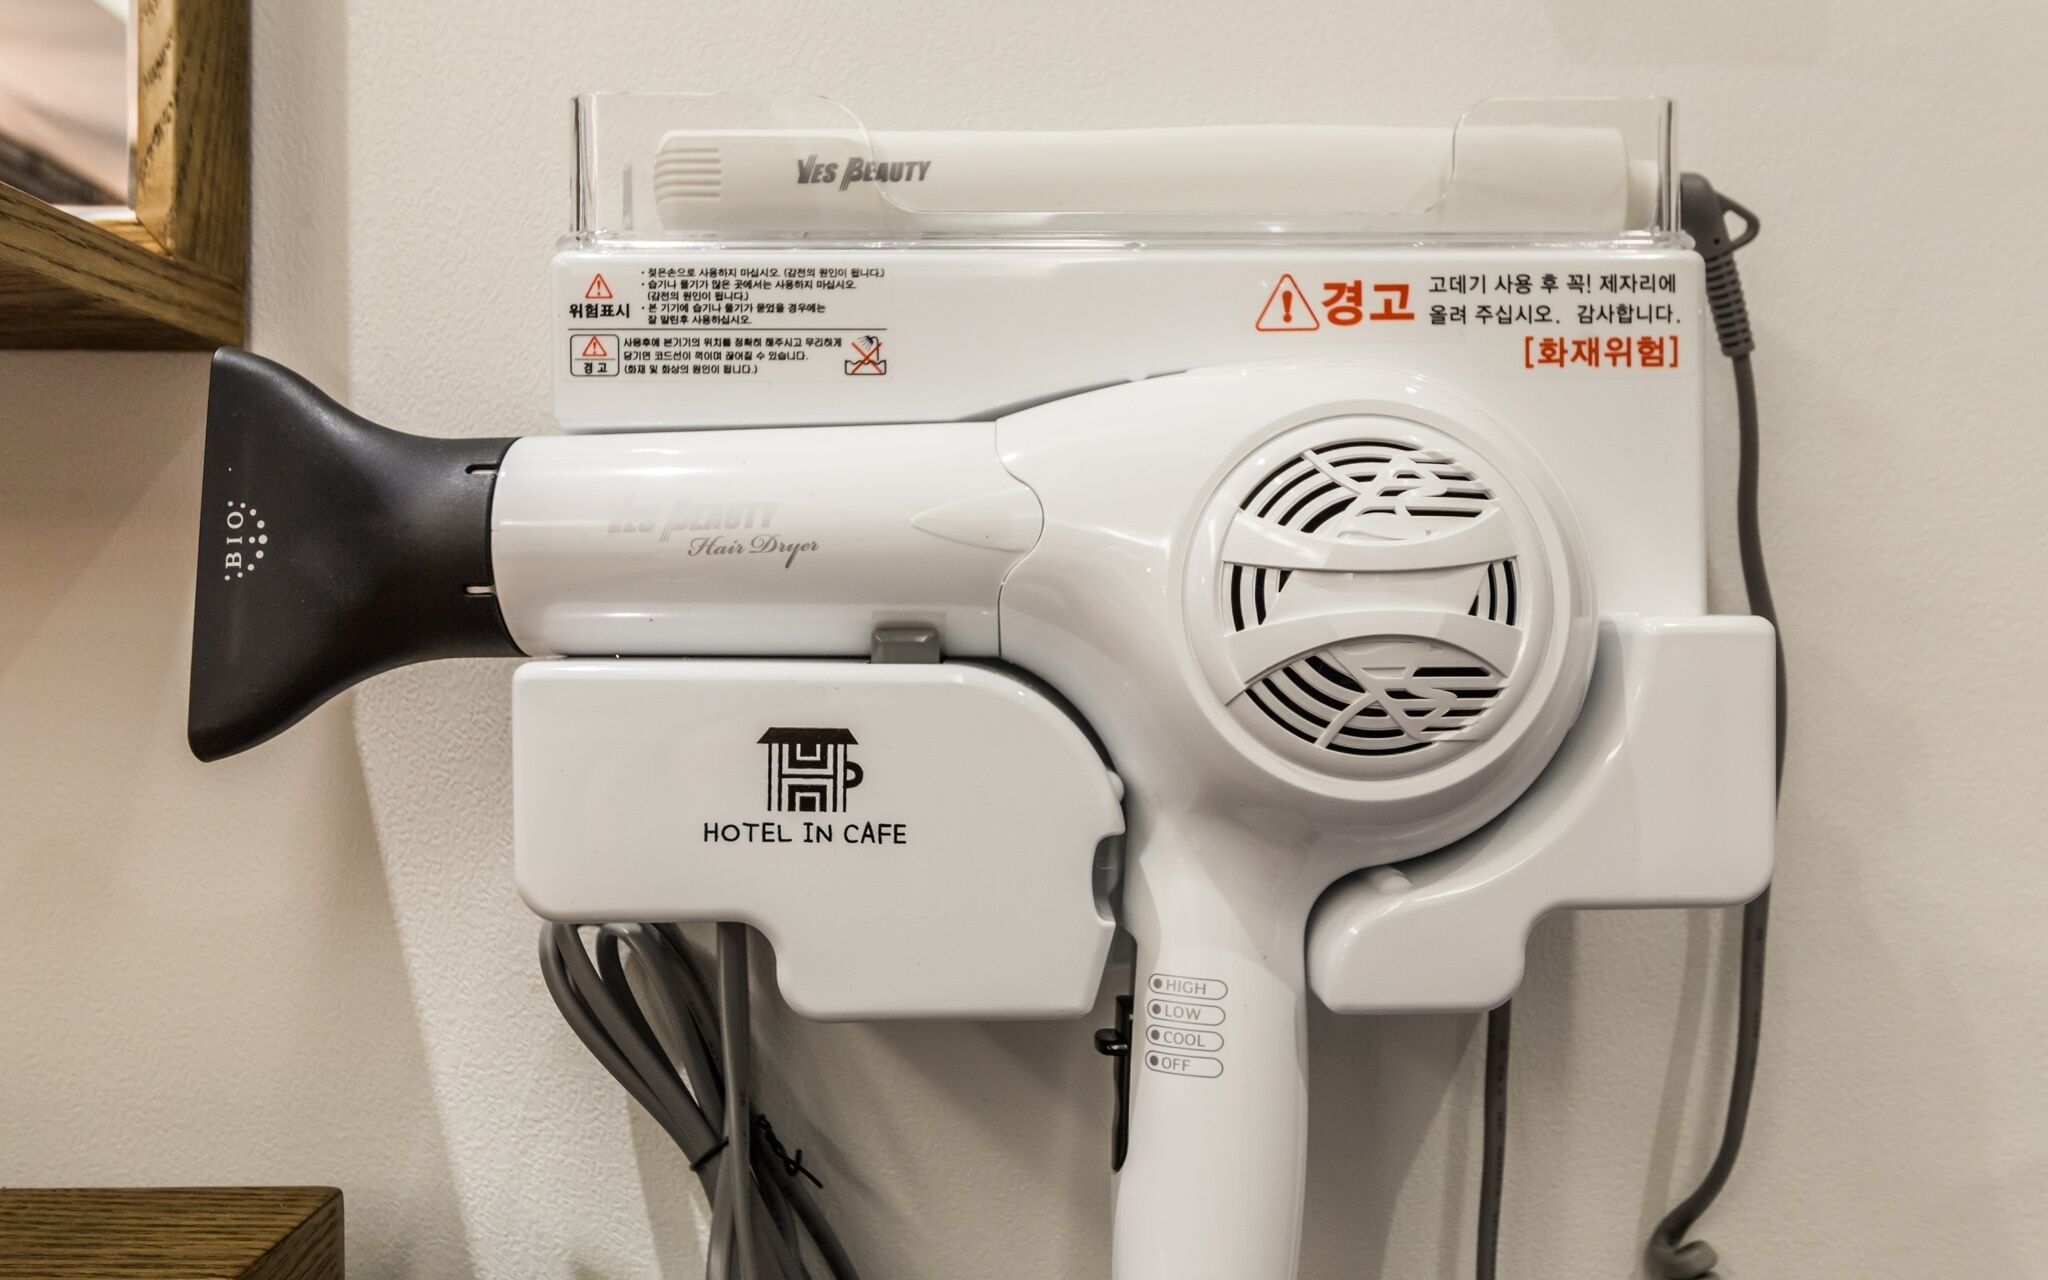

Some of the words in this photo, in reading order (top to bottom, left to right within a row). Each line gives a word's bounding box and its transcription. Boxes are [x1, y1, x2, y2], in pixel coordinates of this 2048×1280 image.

[797, 154, 838, 184] YES
[839, 157, 932, 191] BEAUTY
[648, 268, 696, 278] 젖은손으로
[699, 268, 737, 278] 사용하지
[784, 268, 816, 278] (감전의
[819, 268, 847, 278] 원인이
[648, 279, 677, 290] 습기나
[680, 279, 708, 290] 물기가
[712, 279, 731, 290] 많은
[734, 279, 771, 290] 곳에서는
[775, 279, 813, 290] 사용하지
[1429, 274, 1487, 295] 고데기
[1494, 274, 1531, 295] 사용
[1540, 274, 1559, 295] 후
[1567, 274, 1592, 295] 꼭!
[1599, 274, 1677, 295] 제자리에
[647, 291, 679, 301] (감전의
[683, 291, 711, 301] 원인이
[1322, 280, 1416, 326] 경고
[569, 303, 630, 319] 위험표시
[648, 303, 657, 313] 본
[661, 303, 689, 313] 기기에
[693, 303, 721, 313] 습기나
[725, 303, 753, 313] 물기가
[788, 303, 826, 313] 경우에는
[1429, 304, 1467, 325] 올려
[1475, 304, 1561, 325] 주십시오.
[1577, 304, 1681, 325] 감사합니다.
[648, 314, 657, 325] 잘
[660, 314, 689, 325] 말린후
[624, 337, 660, 347] 사용후에
[664, 337, 700, 347] 본기기의
[704, 337, 731, 347] 위치를
[735, 337, 762, 347] 정확히
[765, 337, 802, 347] 해주시고
[805, 337, 842, 347] 무리하게
[623, 351, 650, 361] 당기면
[655, 351, 691, 361] 코드선이
[756, 351, 765, 361] 수
[769, 351, 809, 361] 있습니다.
[1524, 335, 1680, 369] [화재위험]
[624, 364, 646, 375] (화재
[650, 364, 658, 375] 및
[662, 364, 689, 375] 화상의
[693, 364, 720, 375] 원인이
[723, 364, 758, 375] 됩니다.)
[225, 511, 244, 569] BIO
[688, 536, 744, 557] Hair
[749, 533, 820, 569] Dryer
[704, 822, 792, 843] HOTEL
[803, 822, 833, 843] IN
[844, 821, 907, 844] CAFE
[1166, 979, 1207, 995] HIGH
[1164, 1004, 1202, 1020] LOW
[1163, 1030, 1206, 1047] COOL
[1161, 1056, 1191, 1072] OFF
